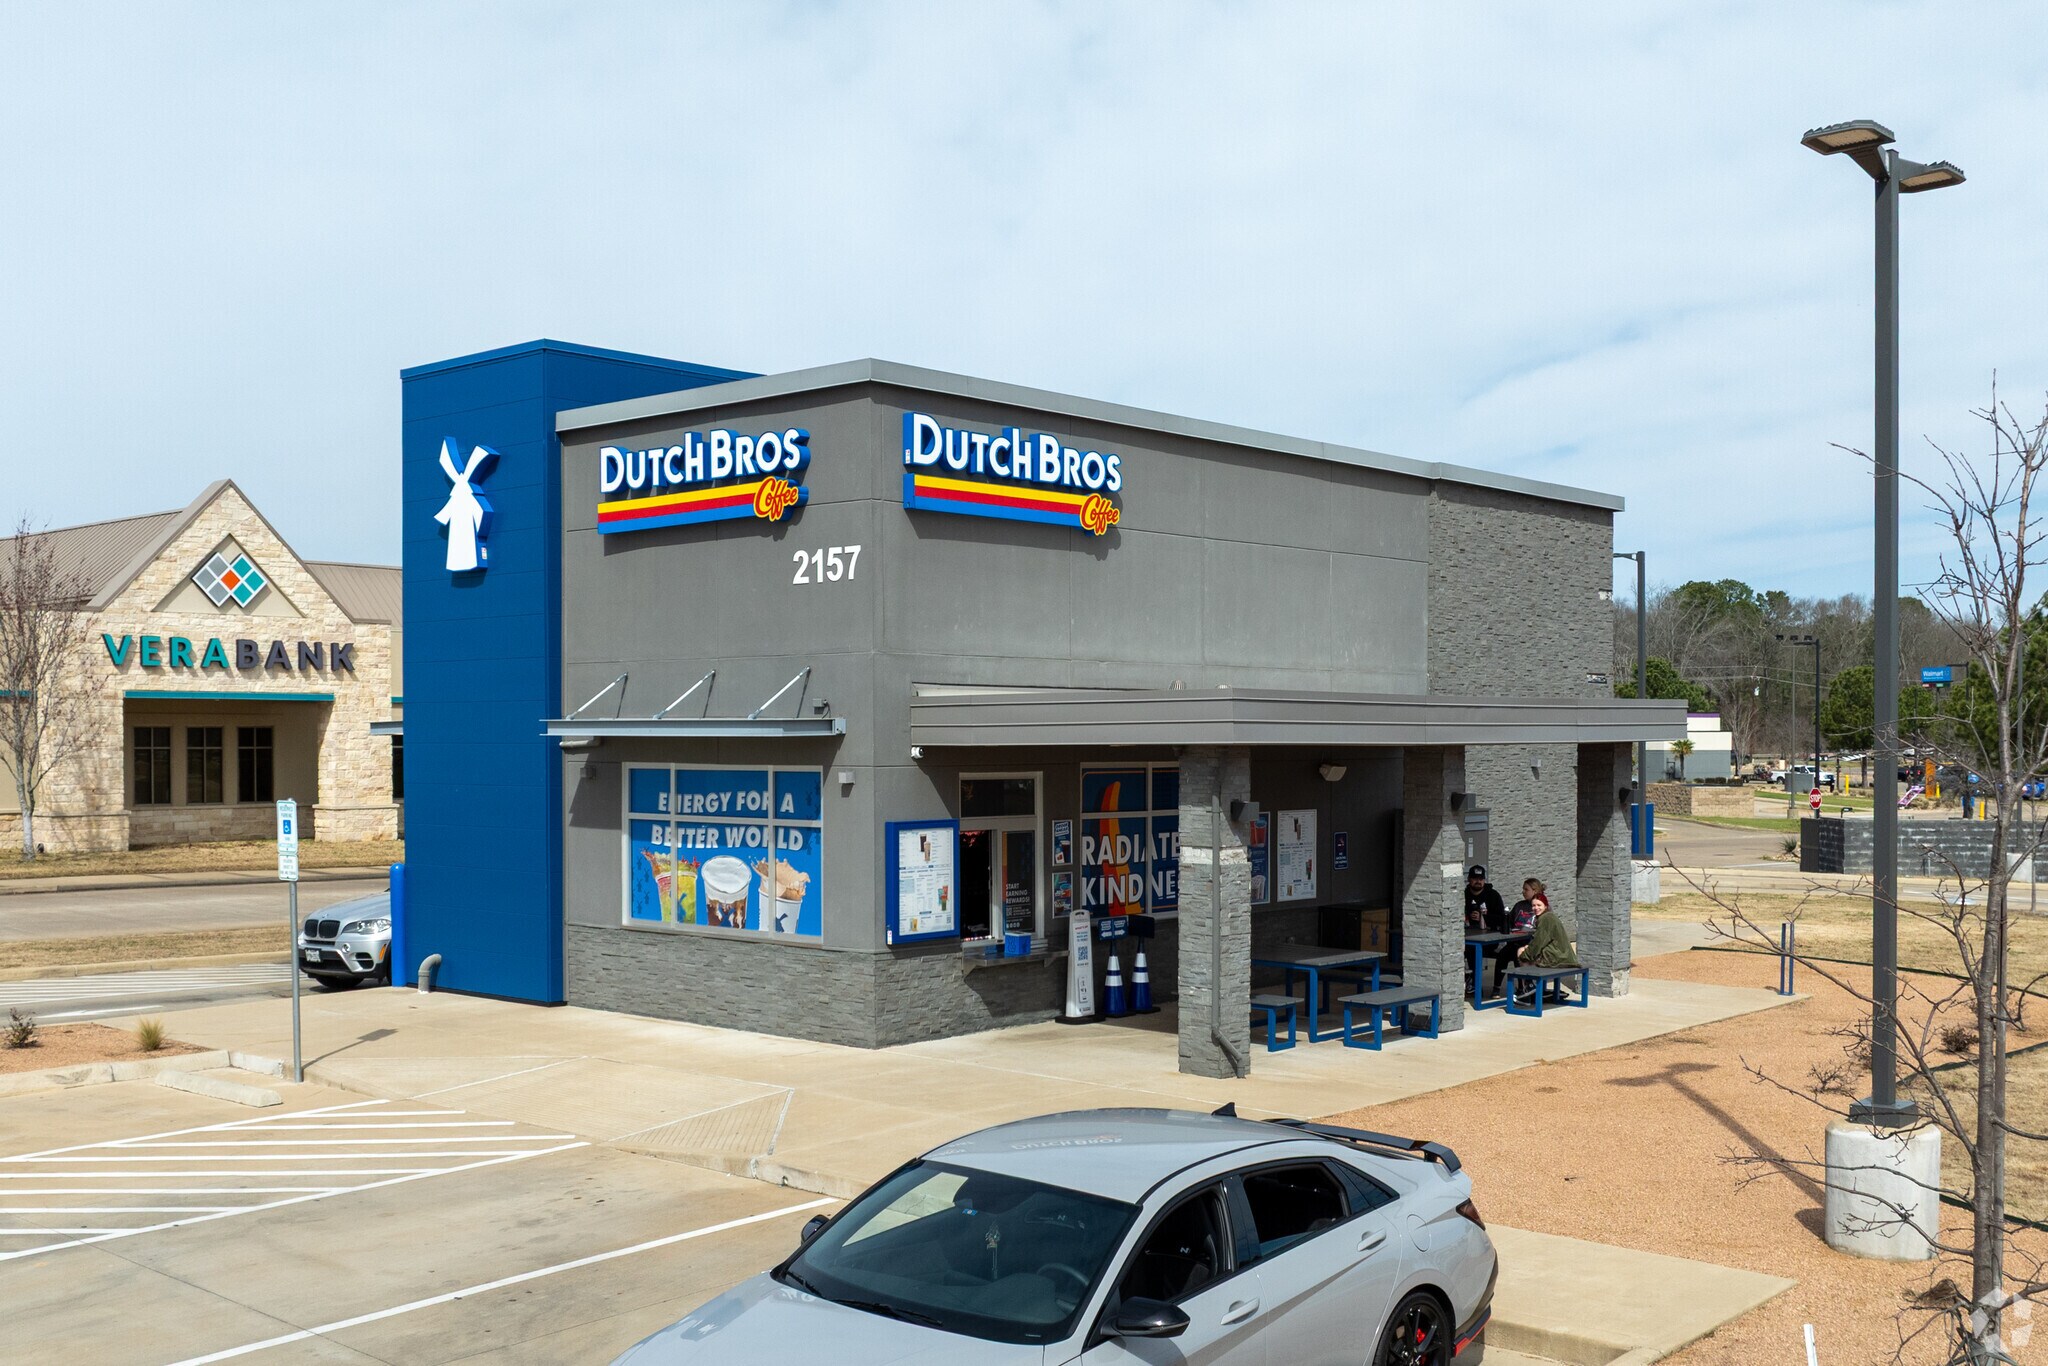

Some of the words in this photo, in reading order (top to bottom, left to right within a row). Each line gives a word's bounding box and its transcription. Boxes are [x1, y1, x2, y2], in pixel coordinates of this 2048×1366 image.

[600, 432, 704, 493] DUTCH
[710, 428, 801, 479] BROS
[912, 413, 1032, 480] DUTCH
[1039, 434, 1122, 491] BROS
[755, 477, 798, 521] Coffee
[1080, 494, 1119, 535] Coffee
[793, 545, 862, 584] 2157
[102, 633, 355, 672] VERABANK
[780, 792, 795, 814] A
[1810, 794, 1821, 803] STOP
[651, 824, 719, 849] BETTER
[1082, 831, 1180, 866] RADIATE
[1005, 882, 1020, 890] START
[1005, 889, 1027, 897] EARNING
[1082, 870, 1176, 906] KINDNE
